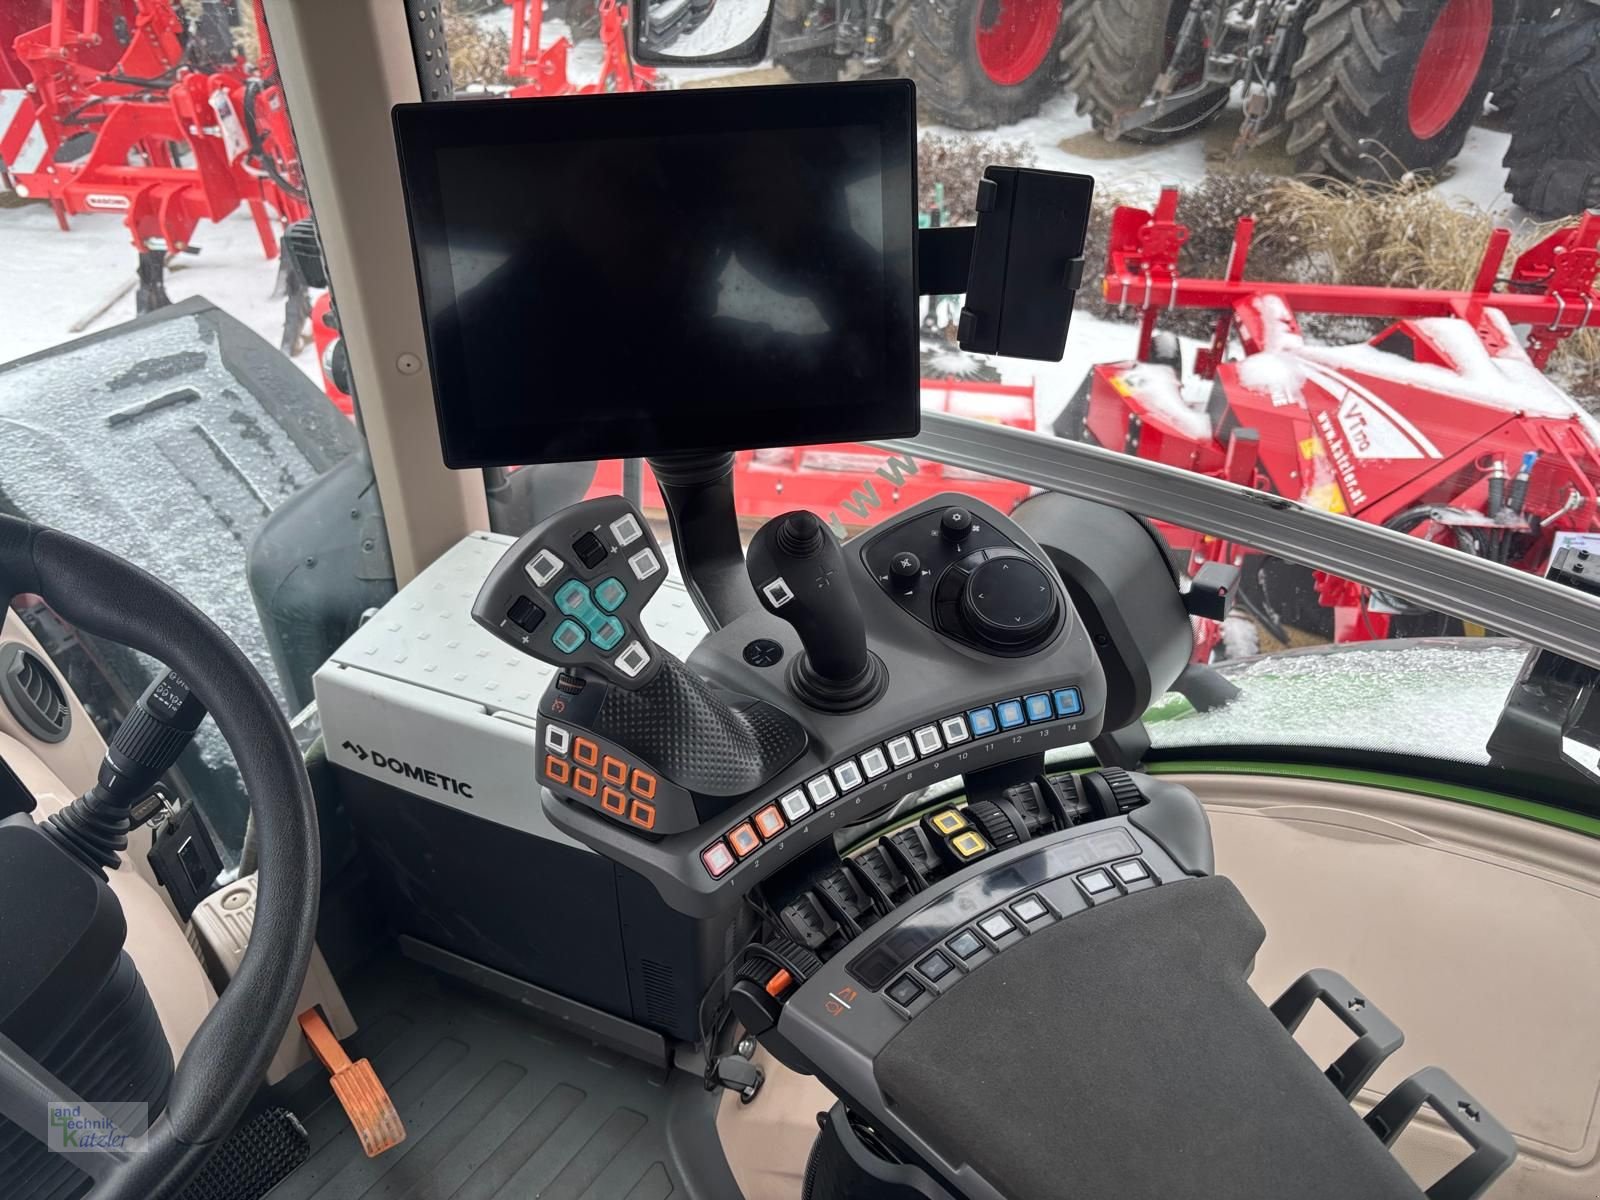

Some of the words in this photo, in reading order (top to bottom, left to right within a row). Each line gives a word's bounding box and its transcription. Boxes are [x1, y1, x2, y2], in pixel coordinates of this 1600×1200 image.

[957, 752, 969, 761] 10
[984, 743, 995, 752] 11
[1012, 735, 1023, 744] 12
[1039, 729, 1050, 737] 13
[1067, 723, 1077, 731] 14
[371, 750, 473, 799] DOMETIC
